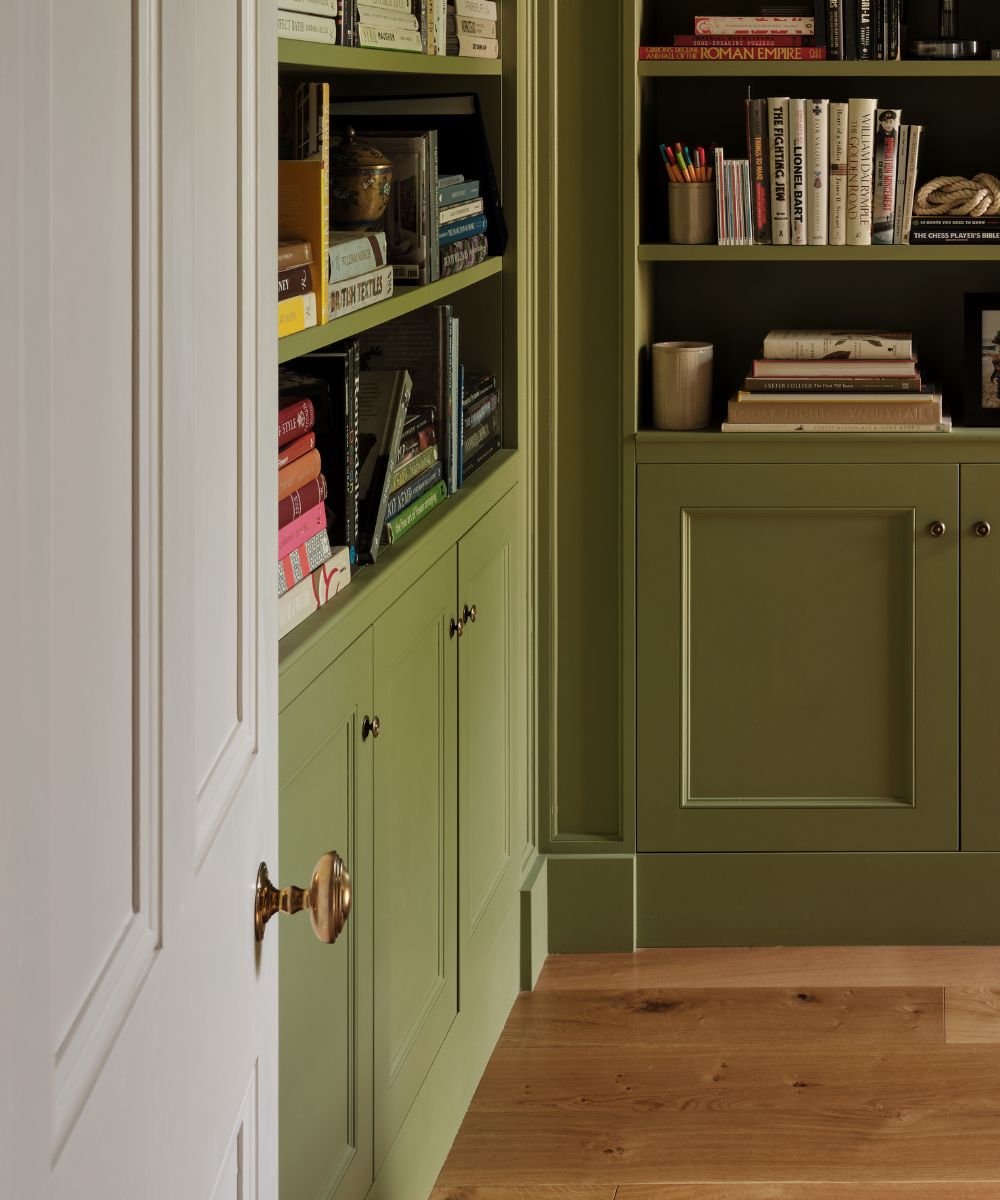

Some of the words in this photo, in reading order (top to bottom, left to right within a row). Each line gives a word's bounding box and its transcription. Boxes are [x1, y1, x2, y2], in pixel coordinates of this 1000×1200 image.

[700, 47, 755, 60] ROMAN
[758, 47, 801, 60] EMPIRE
[774, 107, 783, 127] THE
[850, 121, 858, 135] THE
[774, 128, 785, 178] FIGHTING
[861, 113, 871, 161] WILLIAM
[794, 147, 803, 189] LIONEL
[848, 136, 859, 182] GOLDEN
[776, 182, 785, 201] JEW
[794, 191, 803, 222] BART
[848, 185, 858, 220] ROAD
[859, 164, 870, 227] DALRYMPLE
